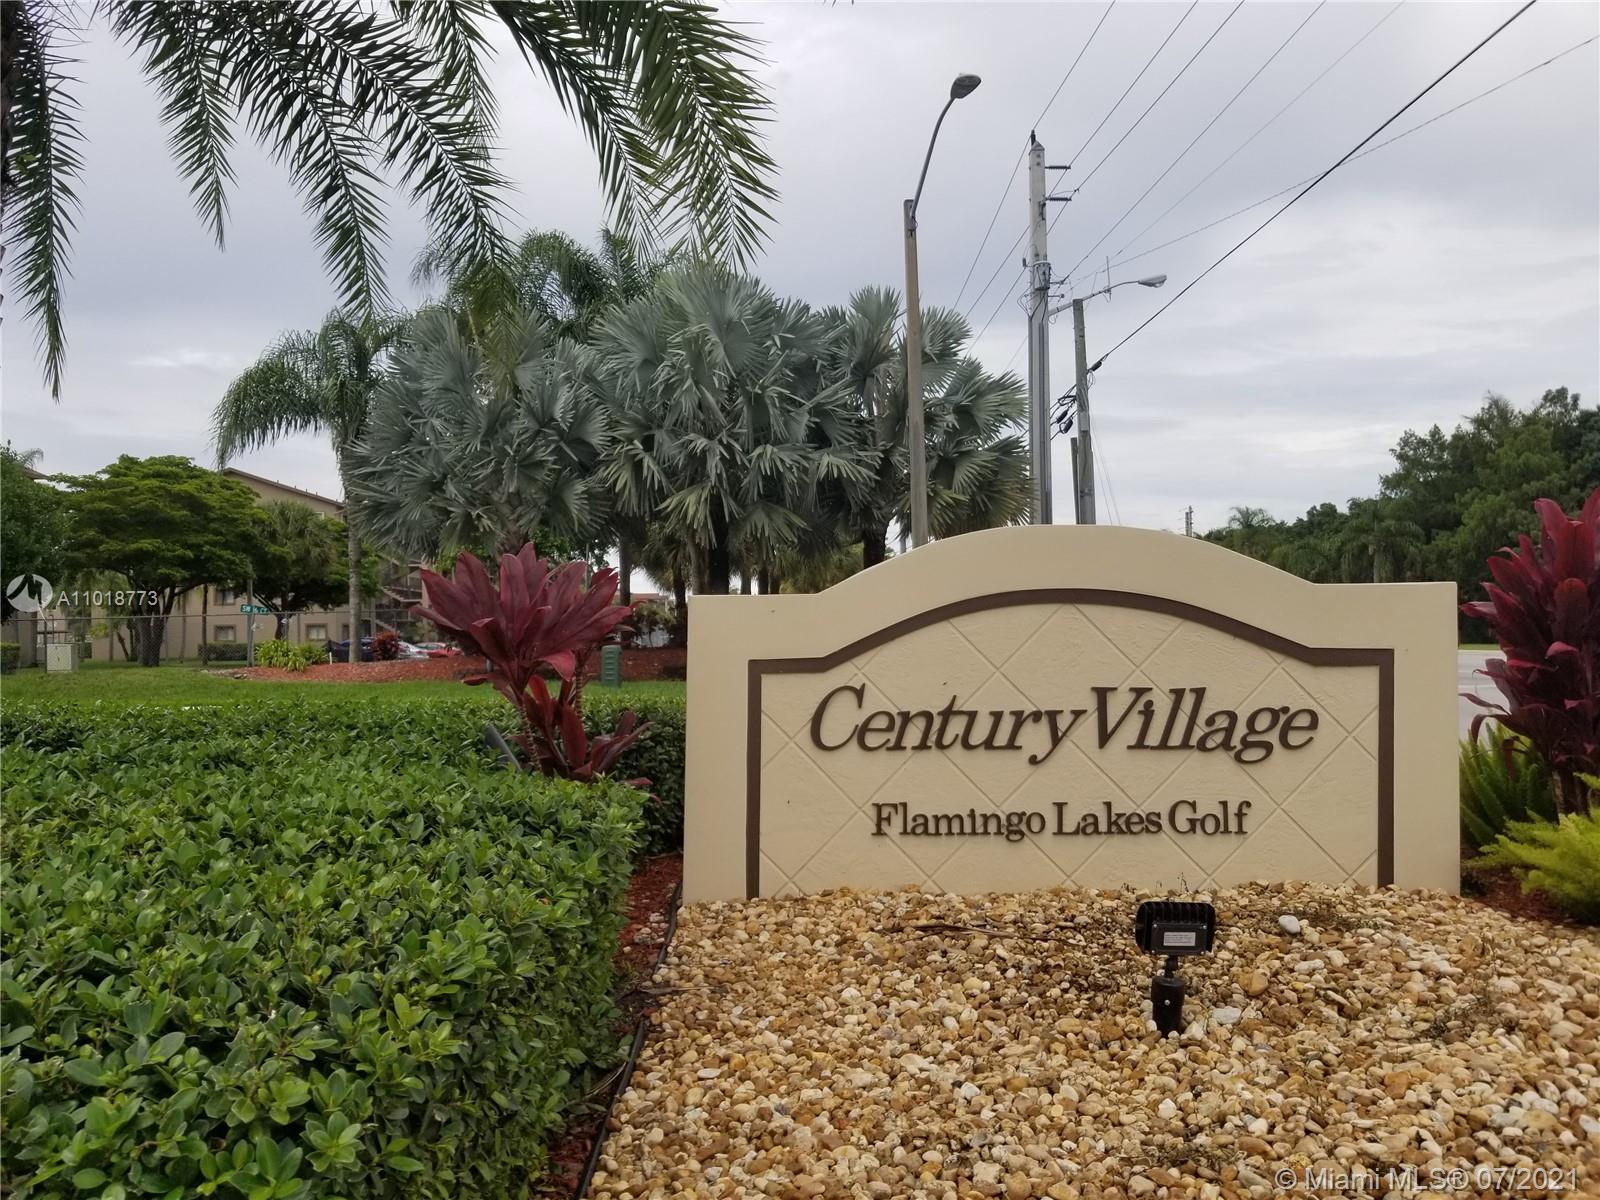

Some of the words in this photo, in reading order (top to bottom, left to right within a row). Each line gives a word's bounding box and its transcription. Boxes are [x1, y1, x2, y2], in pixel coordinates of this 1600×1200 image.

[809, 682, 1088, 766] Century
[1090, 686, 1319, 765] Village
[871, 801, 1046, 843] Flamingo
[1052, 801, 1163, 837] Lakes
[1168, 799, 1252, 836] Golf
